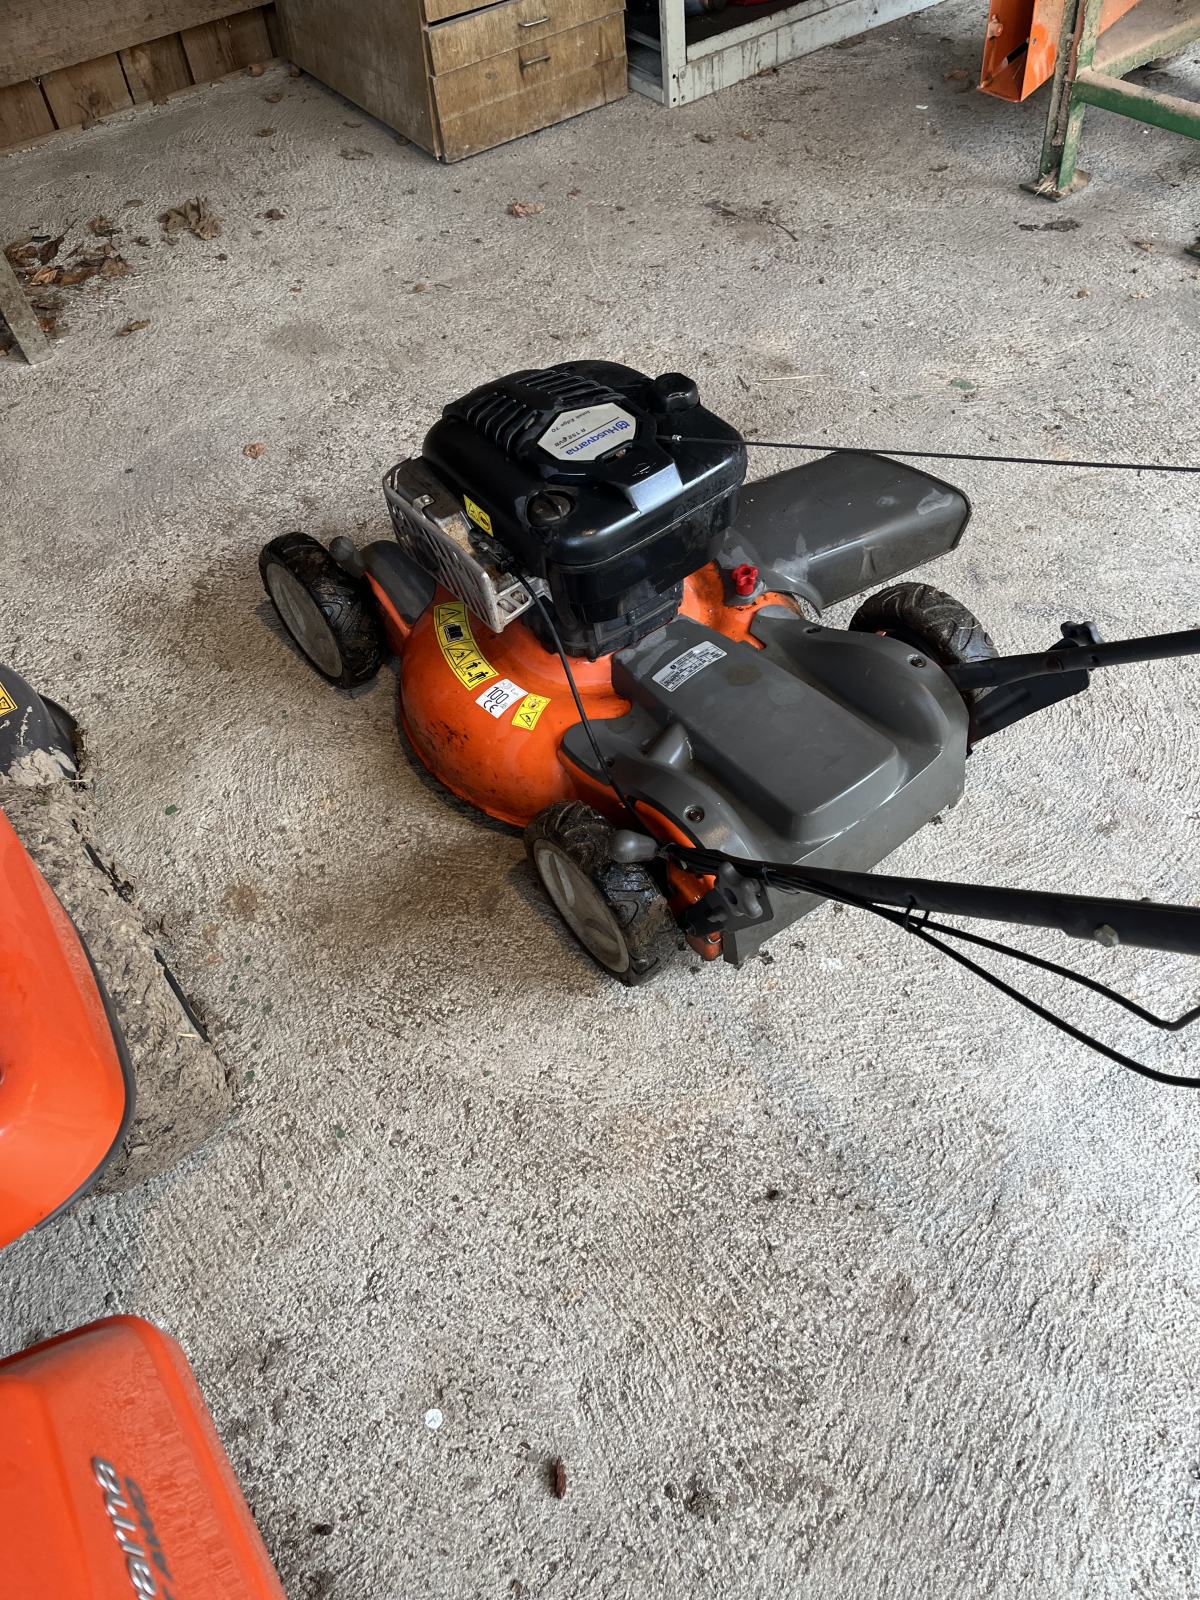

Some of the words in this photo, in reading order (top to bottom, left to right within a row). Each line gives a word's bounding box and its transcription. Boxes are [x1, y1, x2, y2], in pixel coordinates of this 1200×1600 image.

[566, 426, 618, 455] Husqvarna
[483, 700, 498, 713] CE
[486, 686, 510, 705] 100
[91, 1456, 157, 1600] arna
